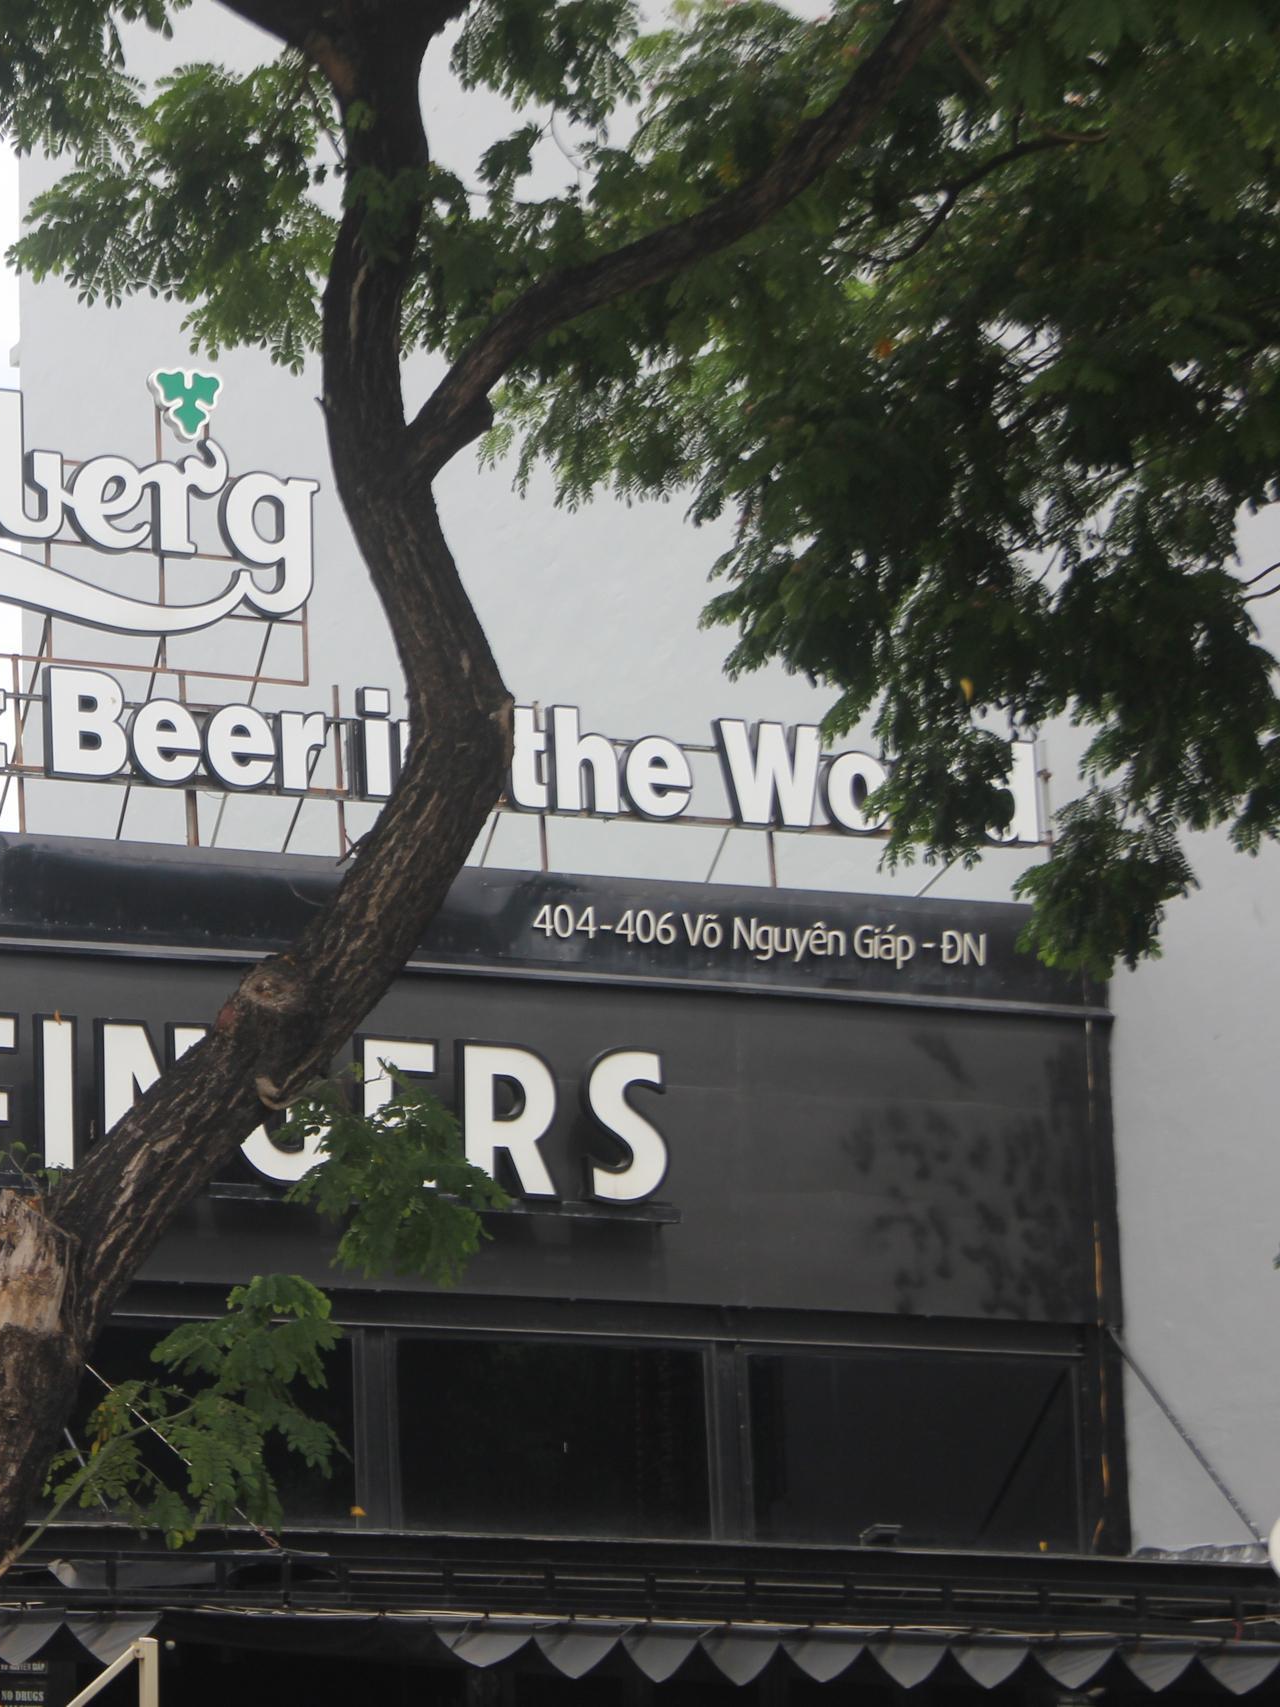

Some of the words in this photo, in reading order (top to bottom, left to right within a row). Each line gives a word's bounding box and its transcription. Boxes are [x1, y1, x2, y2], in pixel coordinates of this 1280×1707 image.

[41, 664, 326, 795] Beer
[355, 685, 410, 798] i
[508, 703, 694, 820] the
[711, 717, 1040, 846] Wod
[532, 904, 677, 946] 404-406
[681, 912, 723, 949] Võ
[853, 923, 916, 970] Giáp
[940, 929, 988, 967] ĐN
[15, 1690, 45, 1702] DRUGS
